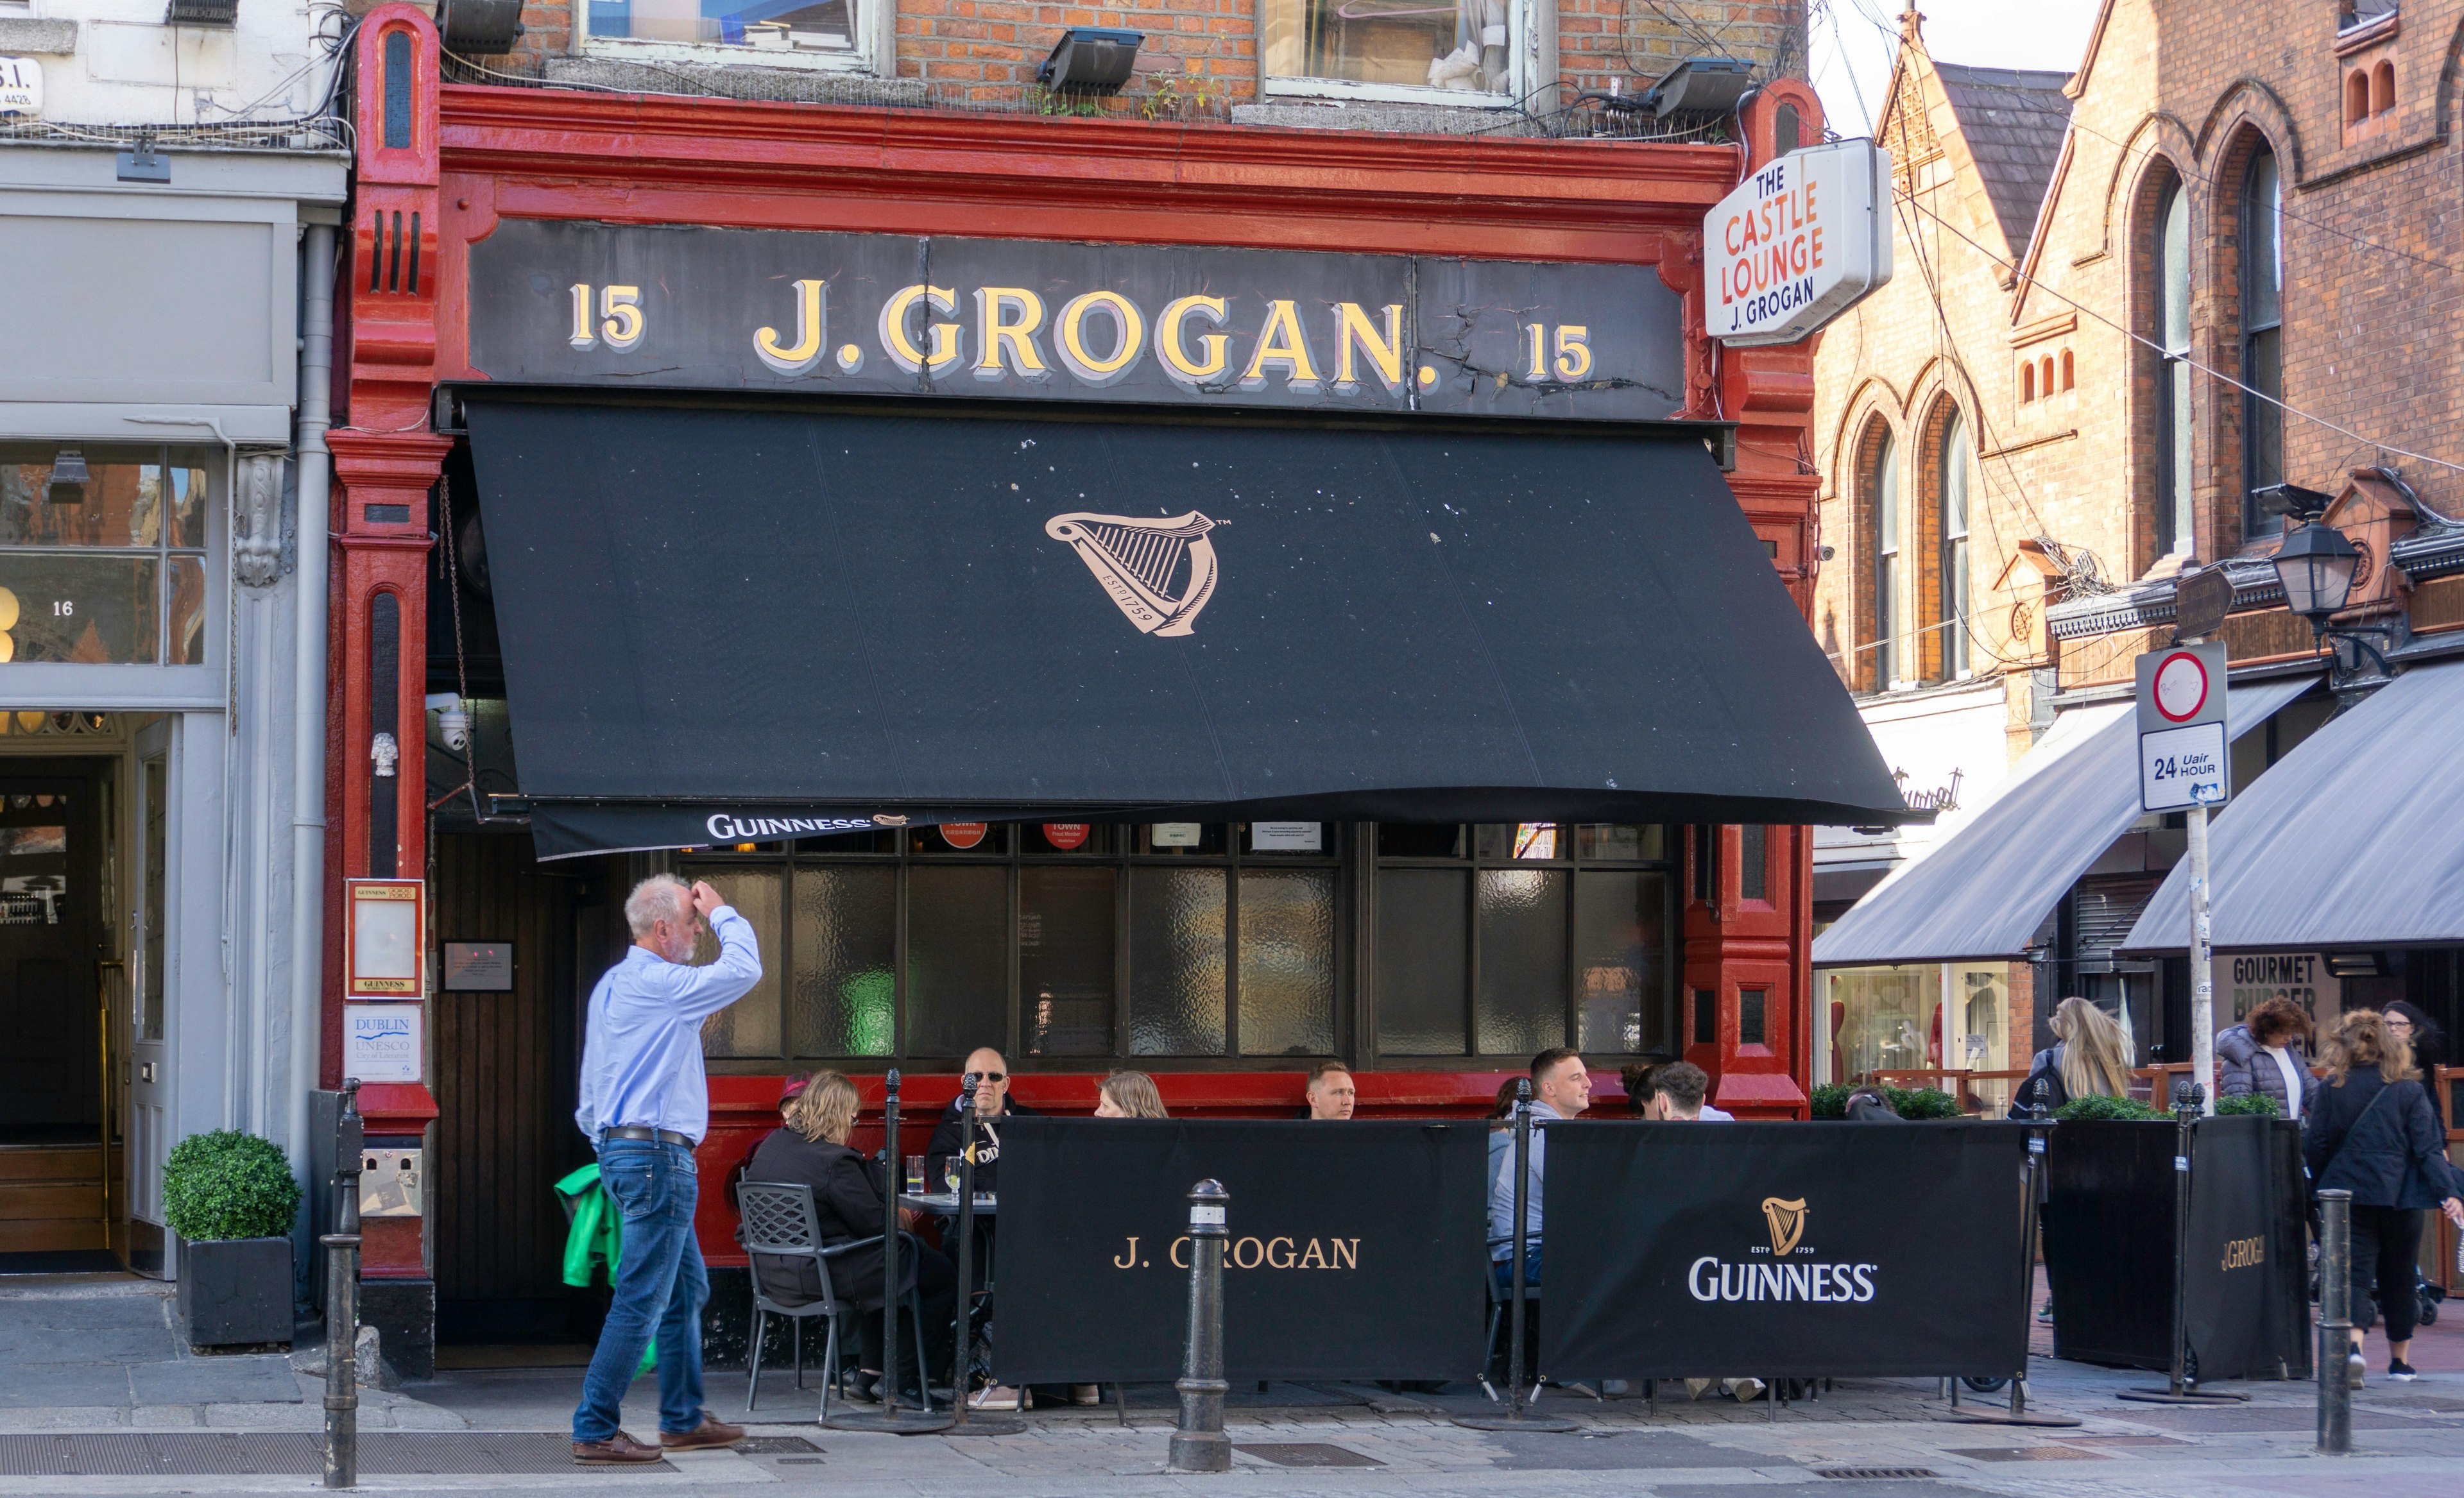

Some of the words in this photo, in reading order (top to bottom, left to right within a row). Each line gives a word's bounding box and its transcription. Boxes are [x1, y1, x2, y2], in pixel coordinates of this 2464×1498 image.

[1757, 165, 1784, 199] THE
[1725, 180, 1817, 256] CASTLE
[1722, 226, 1822, 305] LOUNGE
[570, 284, 646, 352] 15
[1731, 307, 1741, 331] J.
[1747, 276, 1813, 325] GROGAN
[1525, 323, 1595, 383] 15
[54, 600, 73, 616] 16
[1120, 596, 1152, 621] 1759
[2155, 756, 2177, 780] 24
[2181, 764, 2216, 777] HOUR
[2183, 753, 2209, 765] Uair
[706, 813, 871, 839] GUINNESS
[2234, 955, 2316, 985] GOURMET
[355, 1019, 409, 1030] DUBLIN
[355, 1041, 410, 1051] UNESCO
[1114, 1237, 1149, 1269] J.
[1688, 1256, 1876, 1302] GUINNESS
